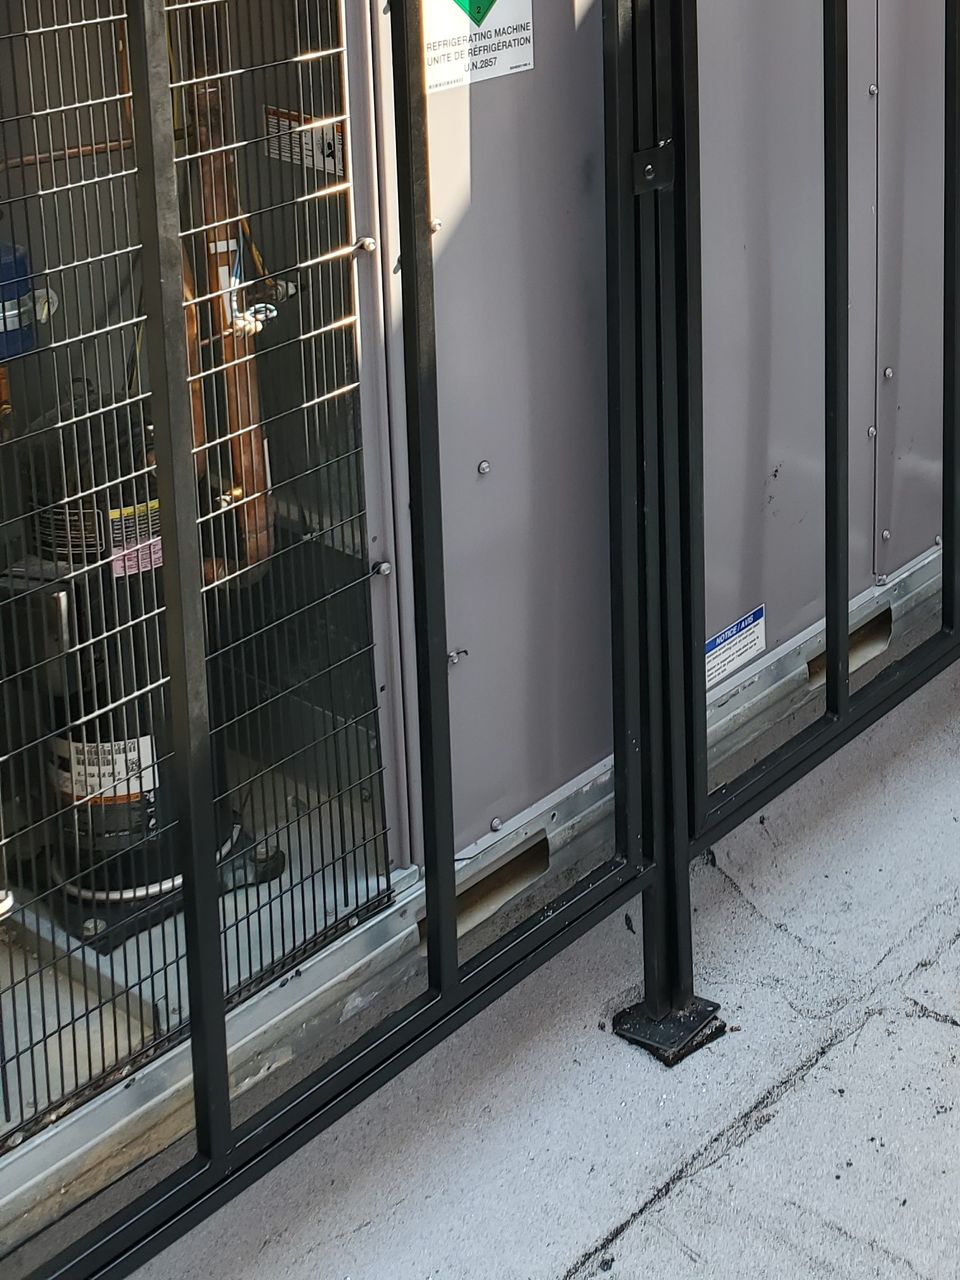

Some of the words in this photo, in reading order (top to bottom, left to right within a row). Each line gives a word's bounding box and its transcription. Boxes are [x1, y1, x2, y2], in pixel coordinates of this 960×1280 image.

[476, 6, 482, 14] 2
[426, 30, 493, 53] REFRIGERATING
[494, 22, 531, 38] MACHINE
[426, 53, 453, 67] UNITE
[454, 49, 466, 61] DE
[467, 35, 531, 58] RÉFRIGÉRATION
[463, 56, 498, 73] U.N.2857
[715, 625, 738, 646] NOTICE
[740, 614, 754, 631] AVIS
